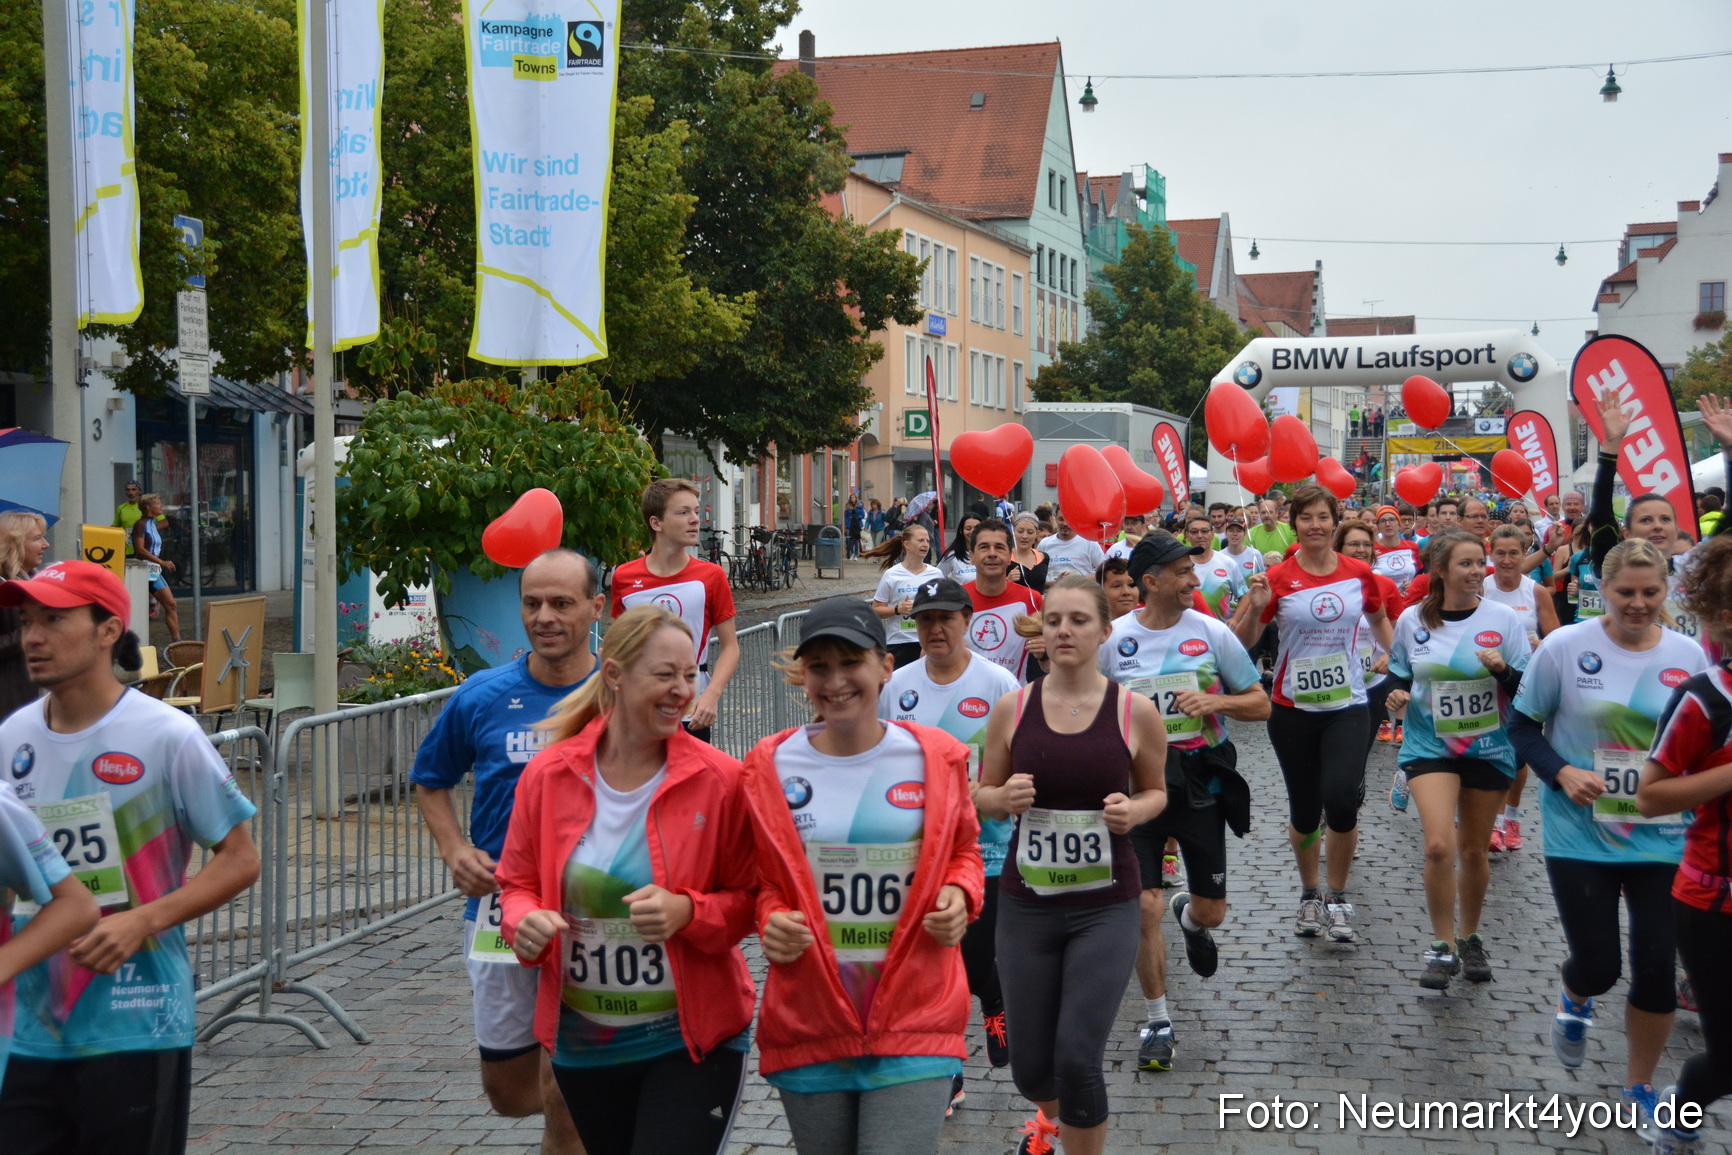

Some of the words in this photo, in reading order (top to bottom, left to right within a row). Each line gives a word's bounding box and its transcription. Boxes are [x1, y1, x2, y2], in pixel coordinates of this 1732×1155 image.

[481, 21, 553, 39] Kampagne
[481, 34, 561, 55] Fairtrade
[515, 60, 556, 74] Towns
[568, 58, 602, 66] FAIRTRADE
[482, 150, 528, 175] Wir
[533, 152, 579, 177] sind
[488, 186, 600, 212] Fairtrade-
[489, 222, 551, 248] Stadt
[1272, 347, 1349, 370] BMW
[1356, 343, 1496, 371] Laufsport
[92, 418, 103, 441] 3
[1513, 420, 1553, 492] REWE
[1157, 432, 1187, 503] REWE
[1182, 643, 1206, 652] Hervis
[1478, 633, 1500, 643] Hervis
[1297, 665, 1346, 691] 5053
[1577, 677, 1604, 686] PARTL
[962, 702, 987, 713] Hervis
[1316, 693, 1331, 702] Eva
[1440, 690, 1494, 717] 5182
[1458, 720, 1481, 731] Anne
[98, 758, 139, 777] Hervis
[41, 800, 101, 821] BOCK
[1055, 814, 1098, 825] BOCK
[1028, 829, 1102, 863] 5193
[1048, 871, 1077, 883] Vera
[570, 940, 665, 986] 5103
[111, 996, 166, 1010] Stadtlauf
[594, 995, 638, 1015] Tanja
